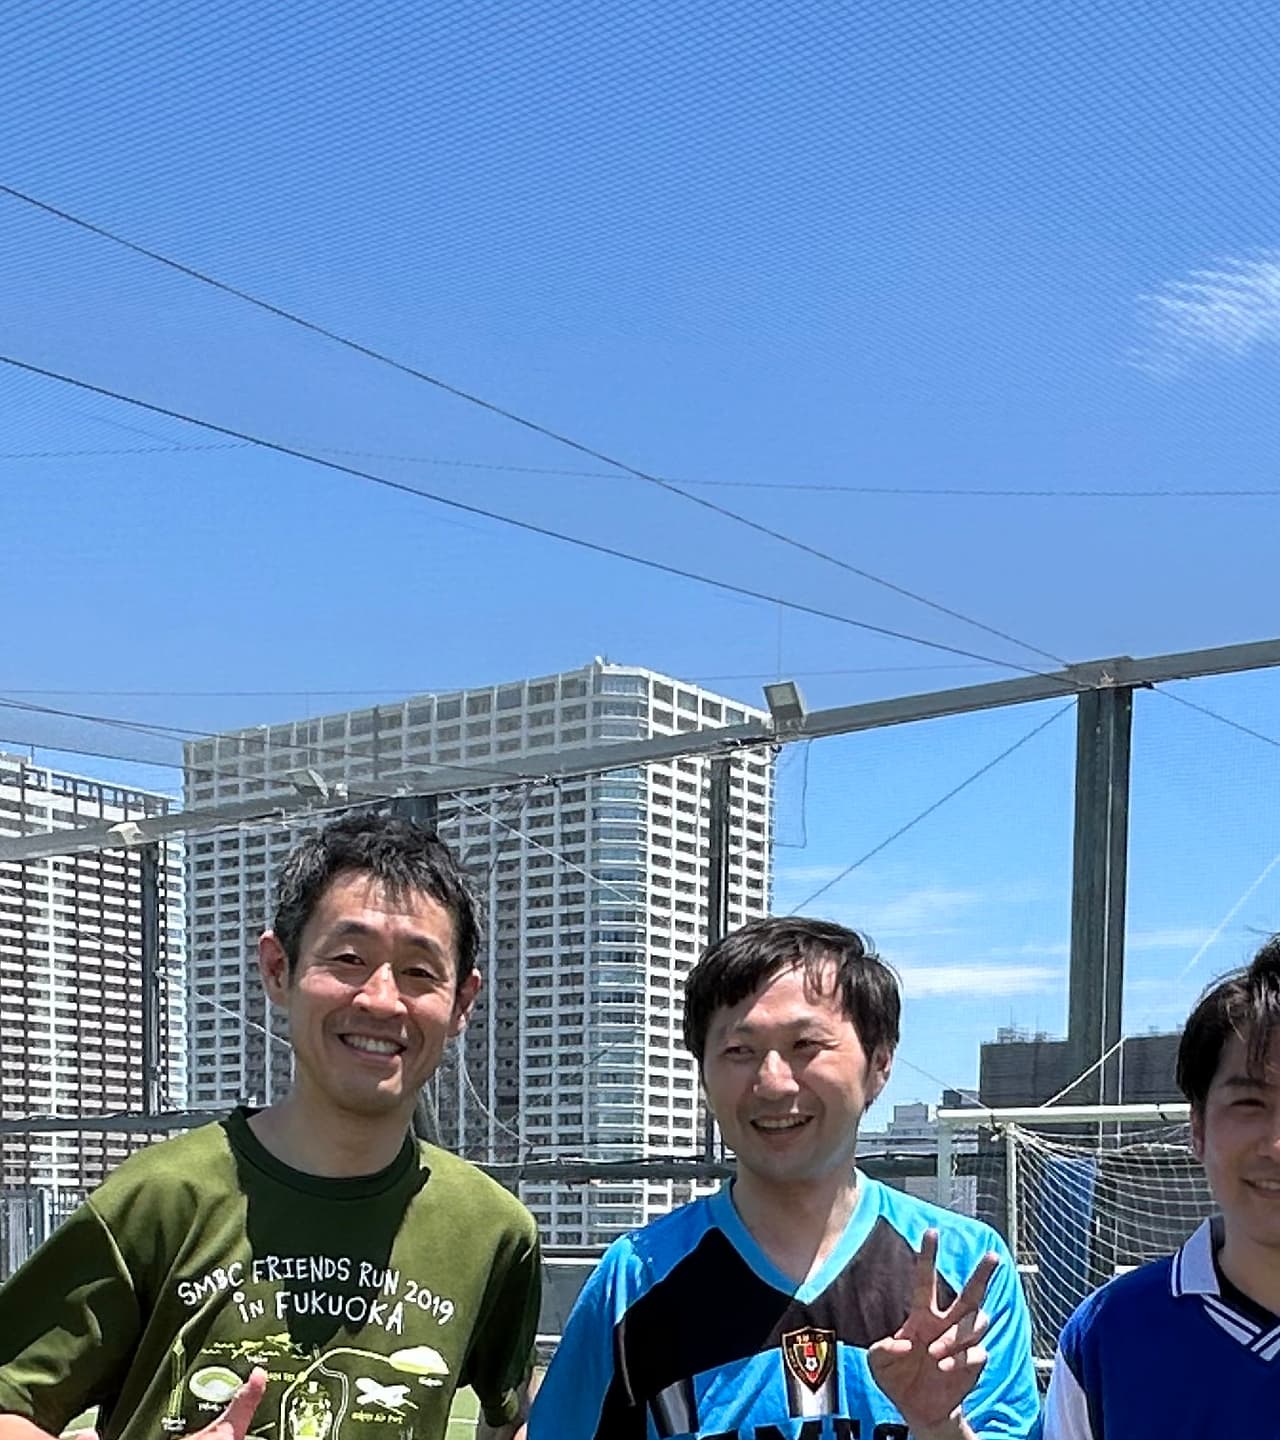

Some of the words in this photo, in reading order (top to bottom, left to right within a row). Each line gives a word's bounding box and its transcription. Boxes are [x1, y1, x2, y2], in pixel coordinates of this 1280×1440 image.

[177, 1262, 244, 1306] SMBC
[252, 1255, 351, 1285] FRIENDS
[358, 1261, 400, 1296] RUN
[404, 1280, 455, 1326] 2019
[275, 1290, 404, 1335] FUKUOKA
